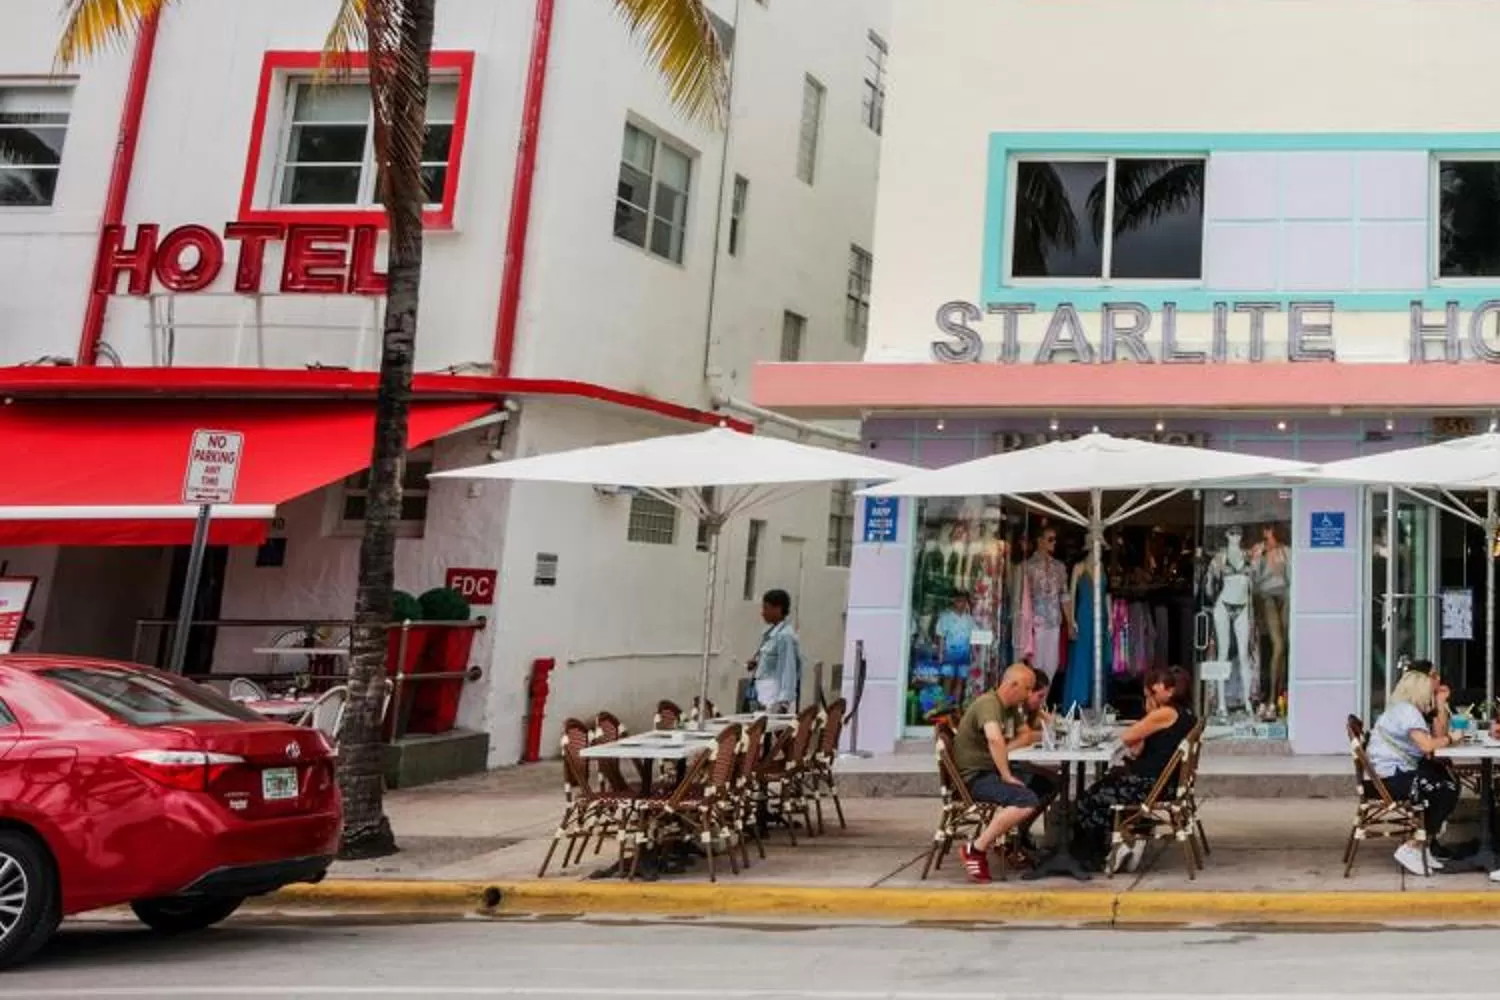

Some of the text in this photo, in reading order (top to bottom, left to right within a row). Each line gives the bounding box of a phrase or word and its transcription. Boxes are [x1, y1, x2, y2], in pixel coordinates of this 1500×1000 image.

[96, 222, 390, 295] HOTEL
[931, 301, 1335, 364] STARLITE
[207, 435, 227, 449] NO
[194, 449, 236, 465] PARKING
[451, 575, 490, 596] FDC
